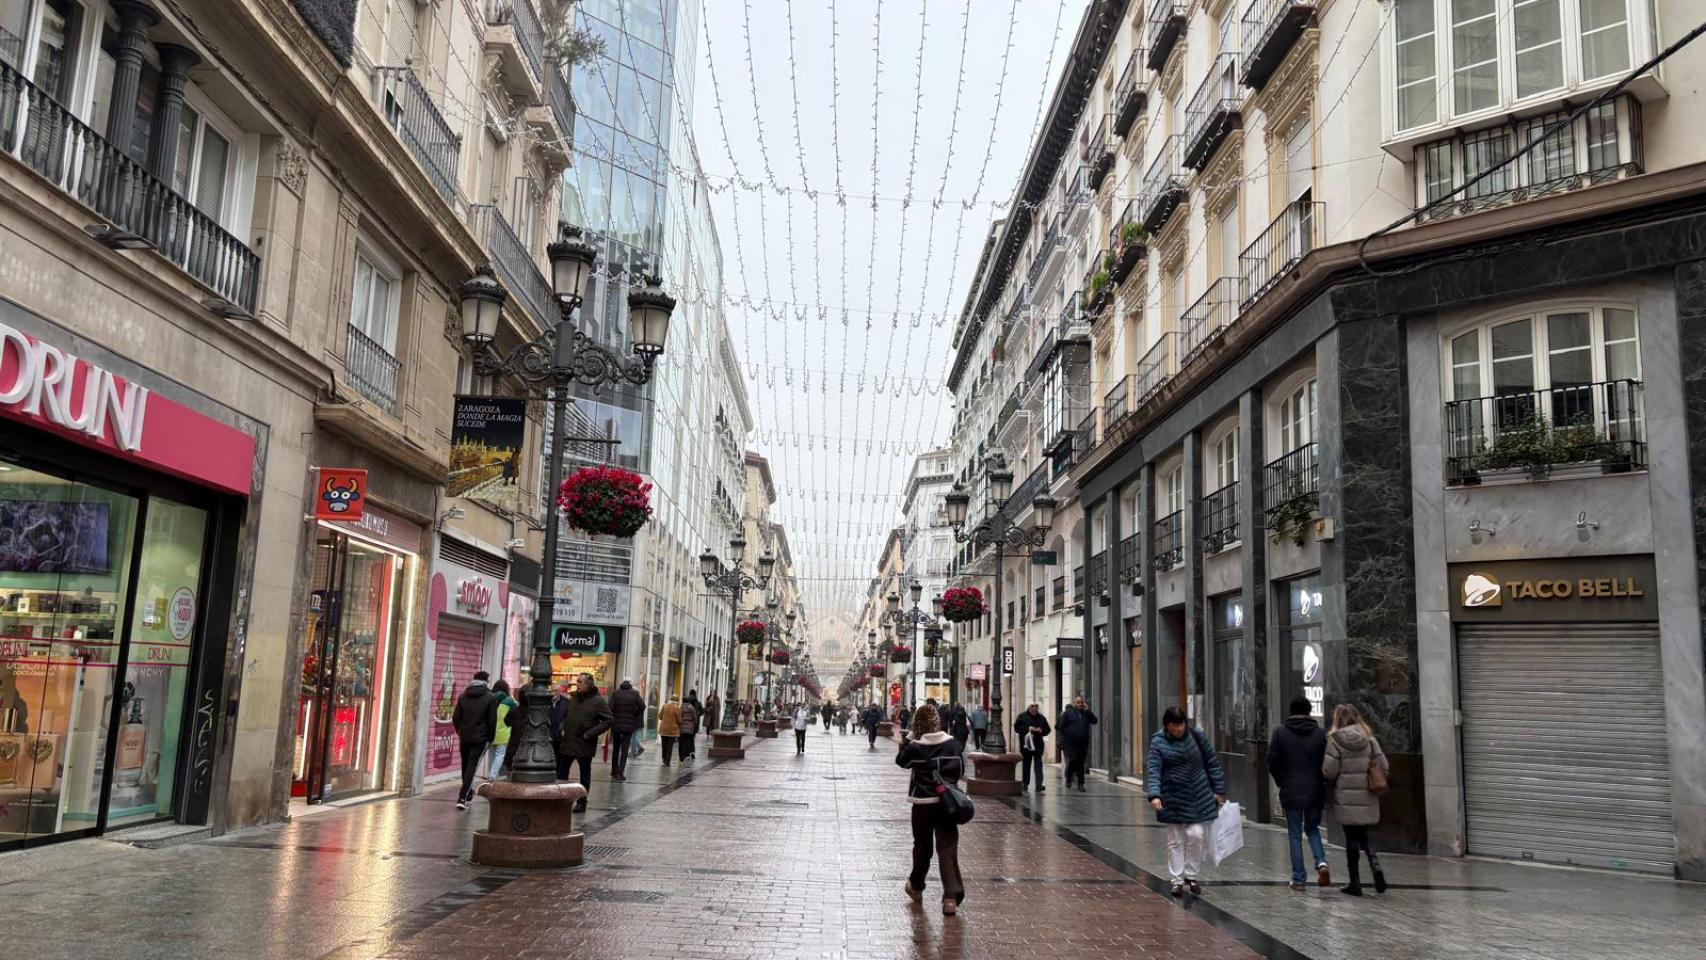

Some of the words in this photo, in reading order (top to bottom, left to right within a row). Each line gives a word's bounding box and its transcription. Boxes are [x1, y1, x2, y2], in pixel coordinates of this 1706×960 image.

[0, 322, 150, 452] DRUNI
[457, 404, 500, 413] ZARAGOZA
[456, 420, 487, 428] SUCEDE
[457, 413, 483, 421] DONDE
[485, 413, 496, 421] LA
[497, 414, 521, 423] MAGIA
[1506, 579, 1573, 599] TACO
[1578, 577, 1643, 597] BELL
[561, 632, 596, 646] Normal
[148, 647, 172, 660] DRUNI
[1303, 686, 1324, 702] TACO
[1309, 702, 1324, 717] ELL
